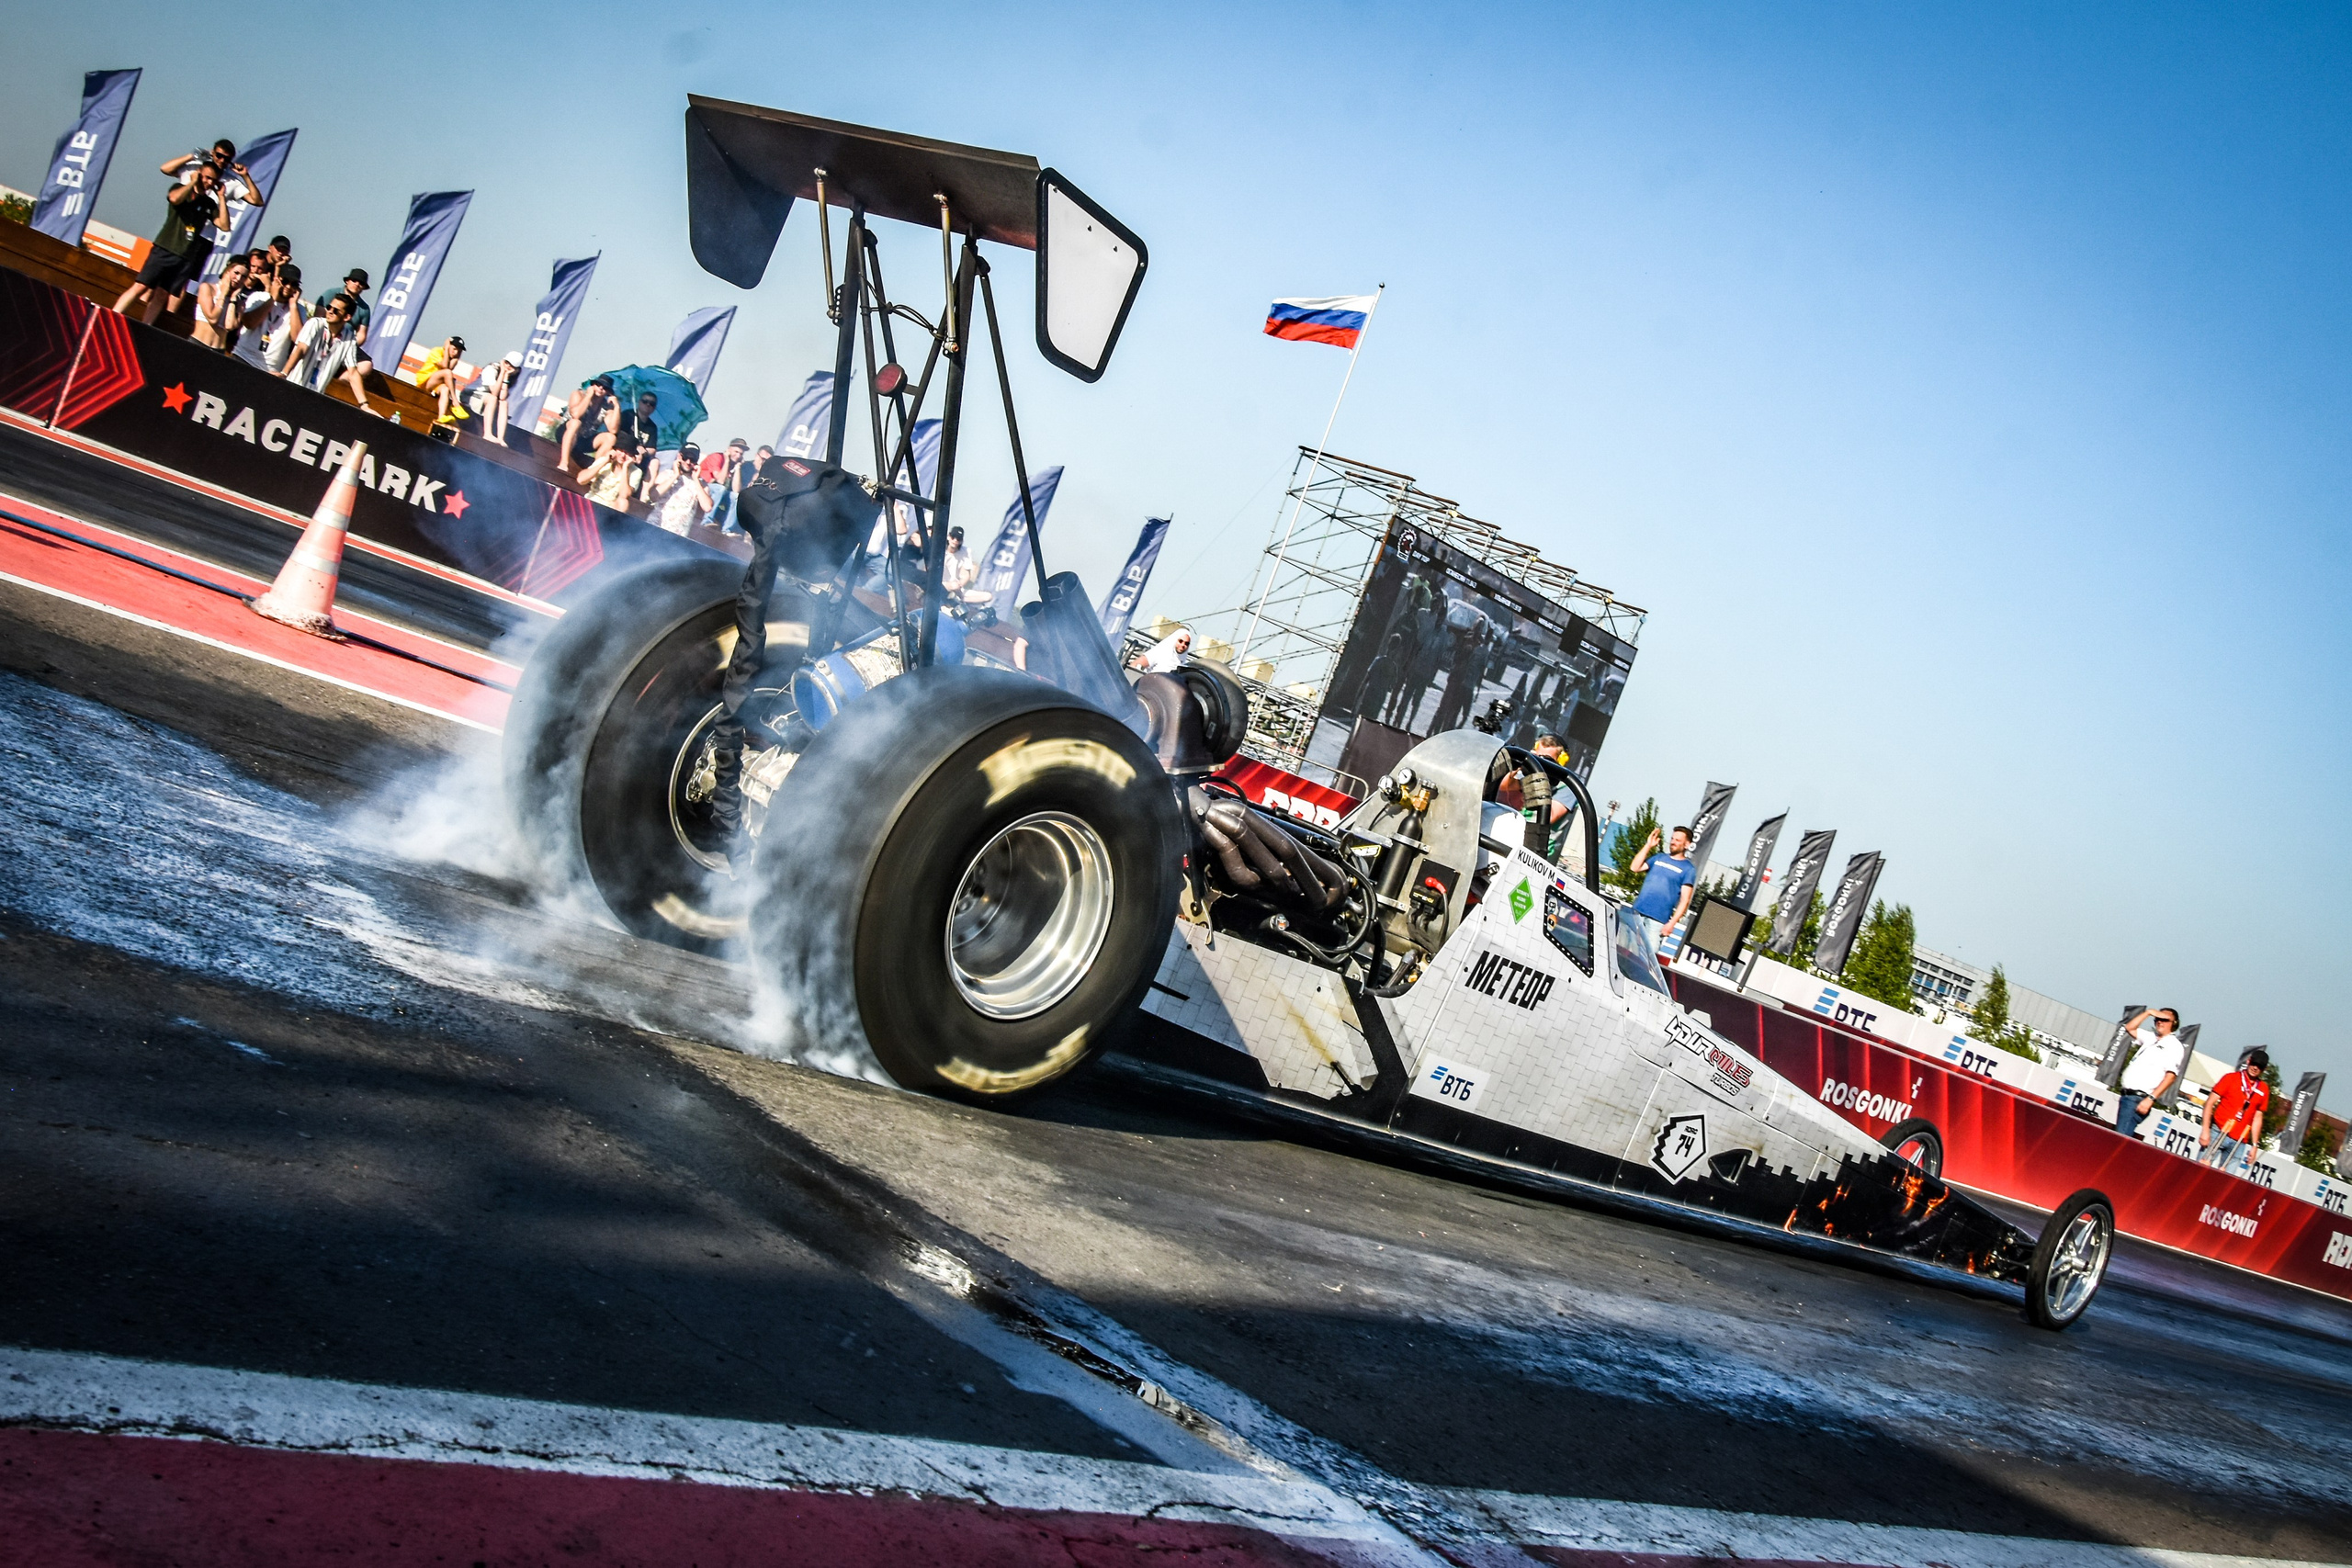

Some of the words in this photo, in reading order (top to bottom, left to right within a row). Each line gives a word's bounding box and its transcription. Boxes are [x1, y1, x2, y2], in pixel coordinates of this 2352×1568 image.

[191, 390, 447, 513] RACEPARK
[1518, 850, 1548, 876] KULIKOV
[1548, 870, 1555, 883] M.
[1464, 950, 1556, 1011] МЕТЕОР
[1440, 1074, 1475, 1101] ВТБ
[1710, 1072, 1740, 1096] TURBOS
[1819, 1077, 1913, 1123] ROSGONKI
[1675, 1134, 1696, 1157] 74
[2199, 1203, 2259, 1238] ROSGONKI
